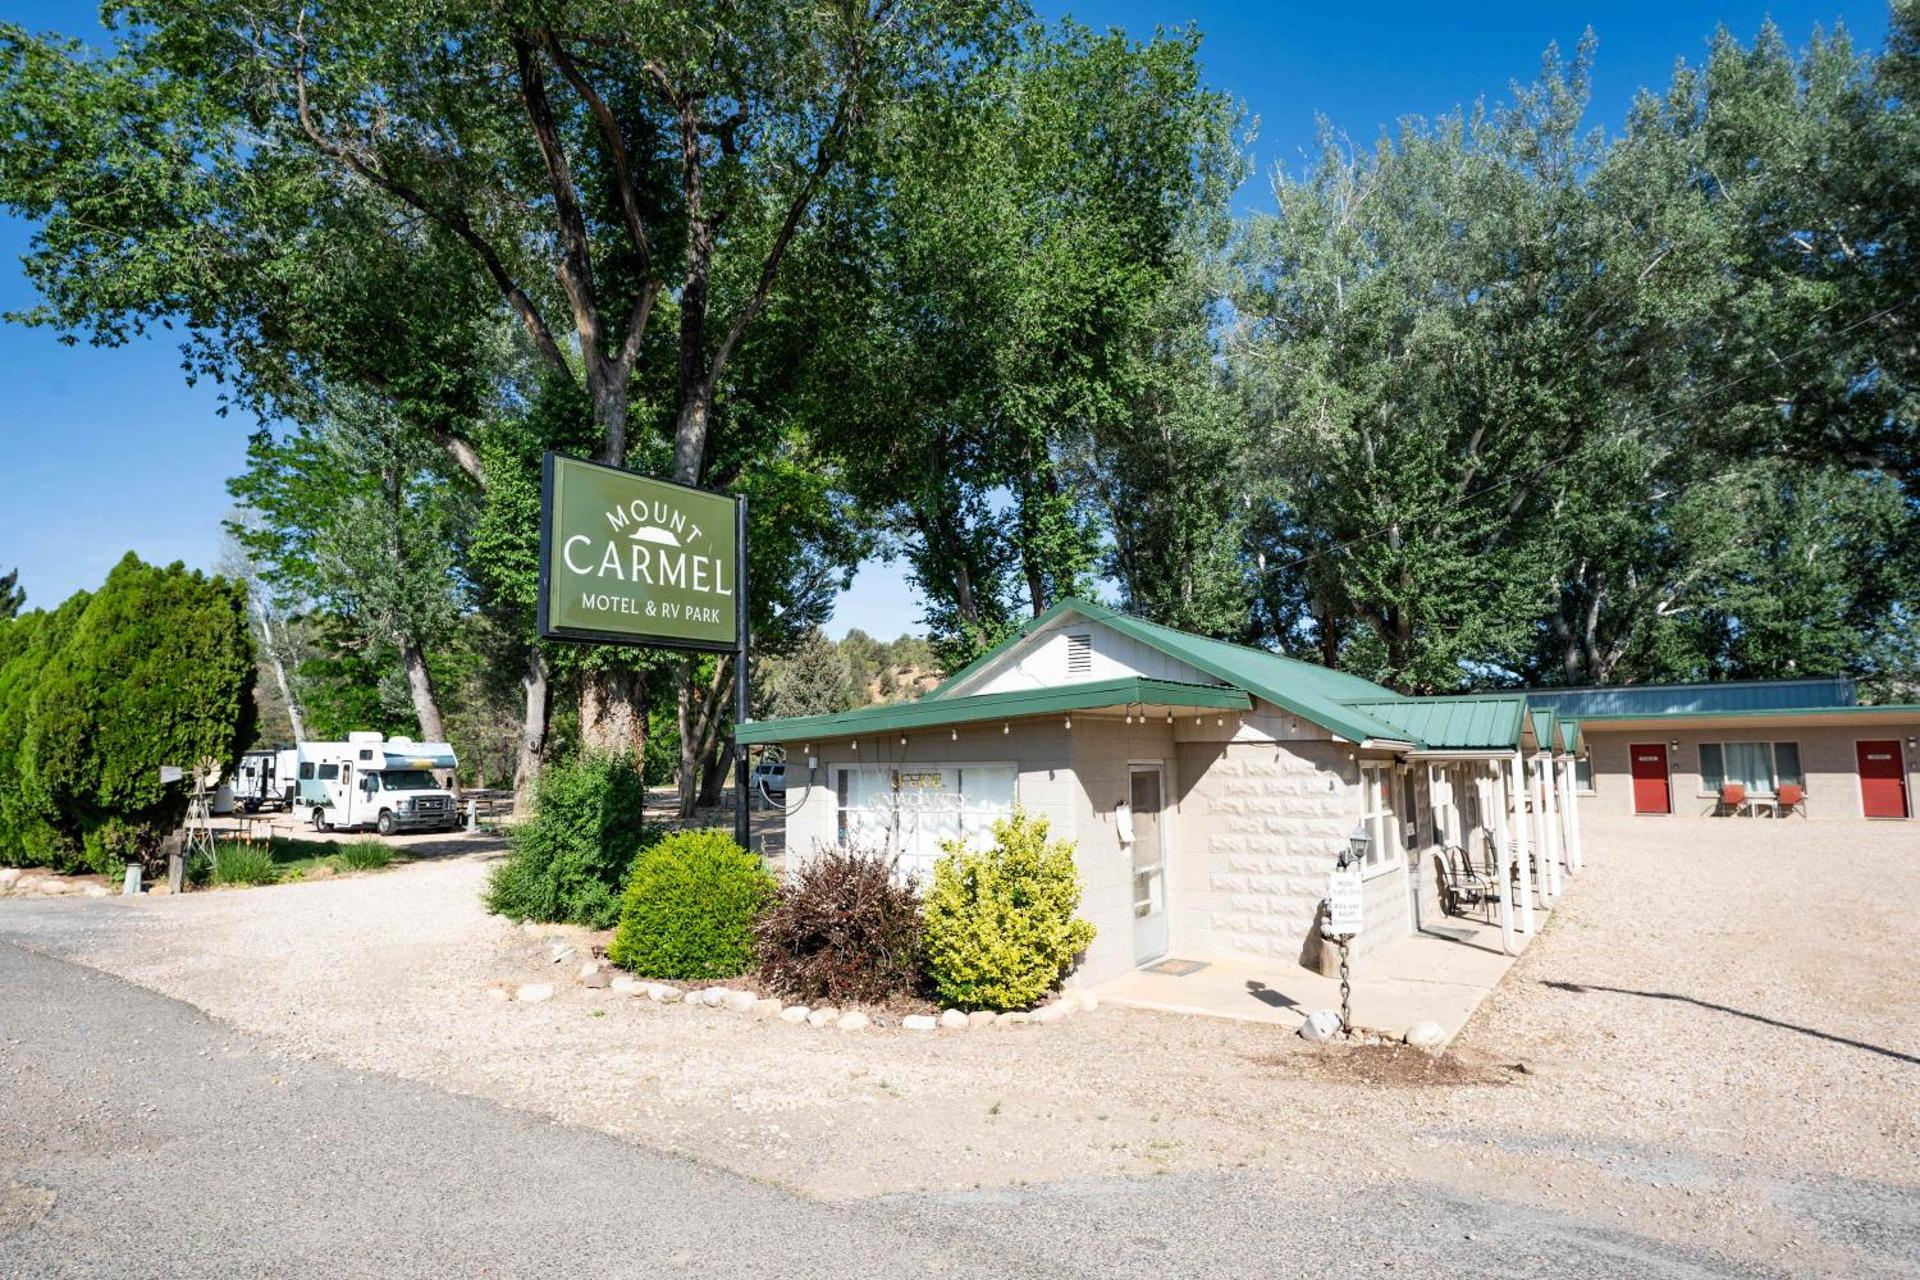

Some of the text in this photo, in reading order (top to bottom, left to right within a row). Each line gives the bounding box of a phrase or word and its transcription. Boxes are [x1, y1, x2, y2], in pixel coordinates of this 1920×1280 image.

[606, 499, 702, 544] MOUNT
[563, 534, 732, 597] CARMEL
[582, 593, 720, 623] MOTEL & RV PARK
